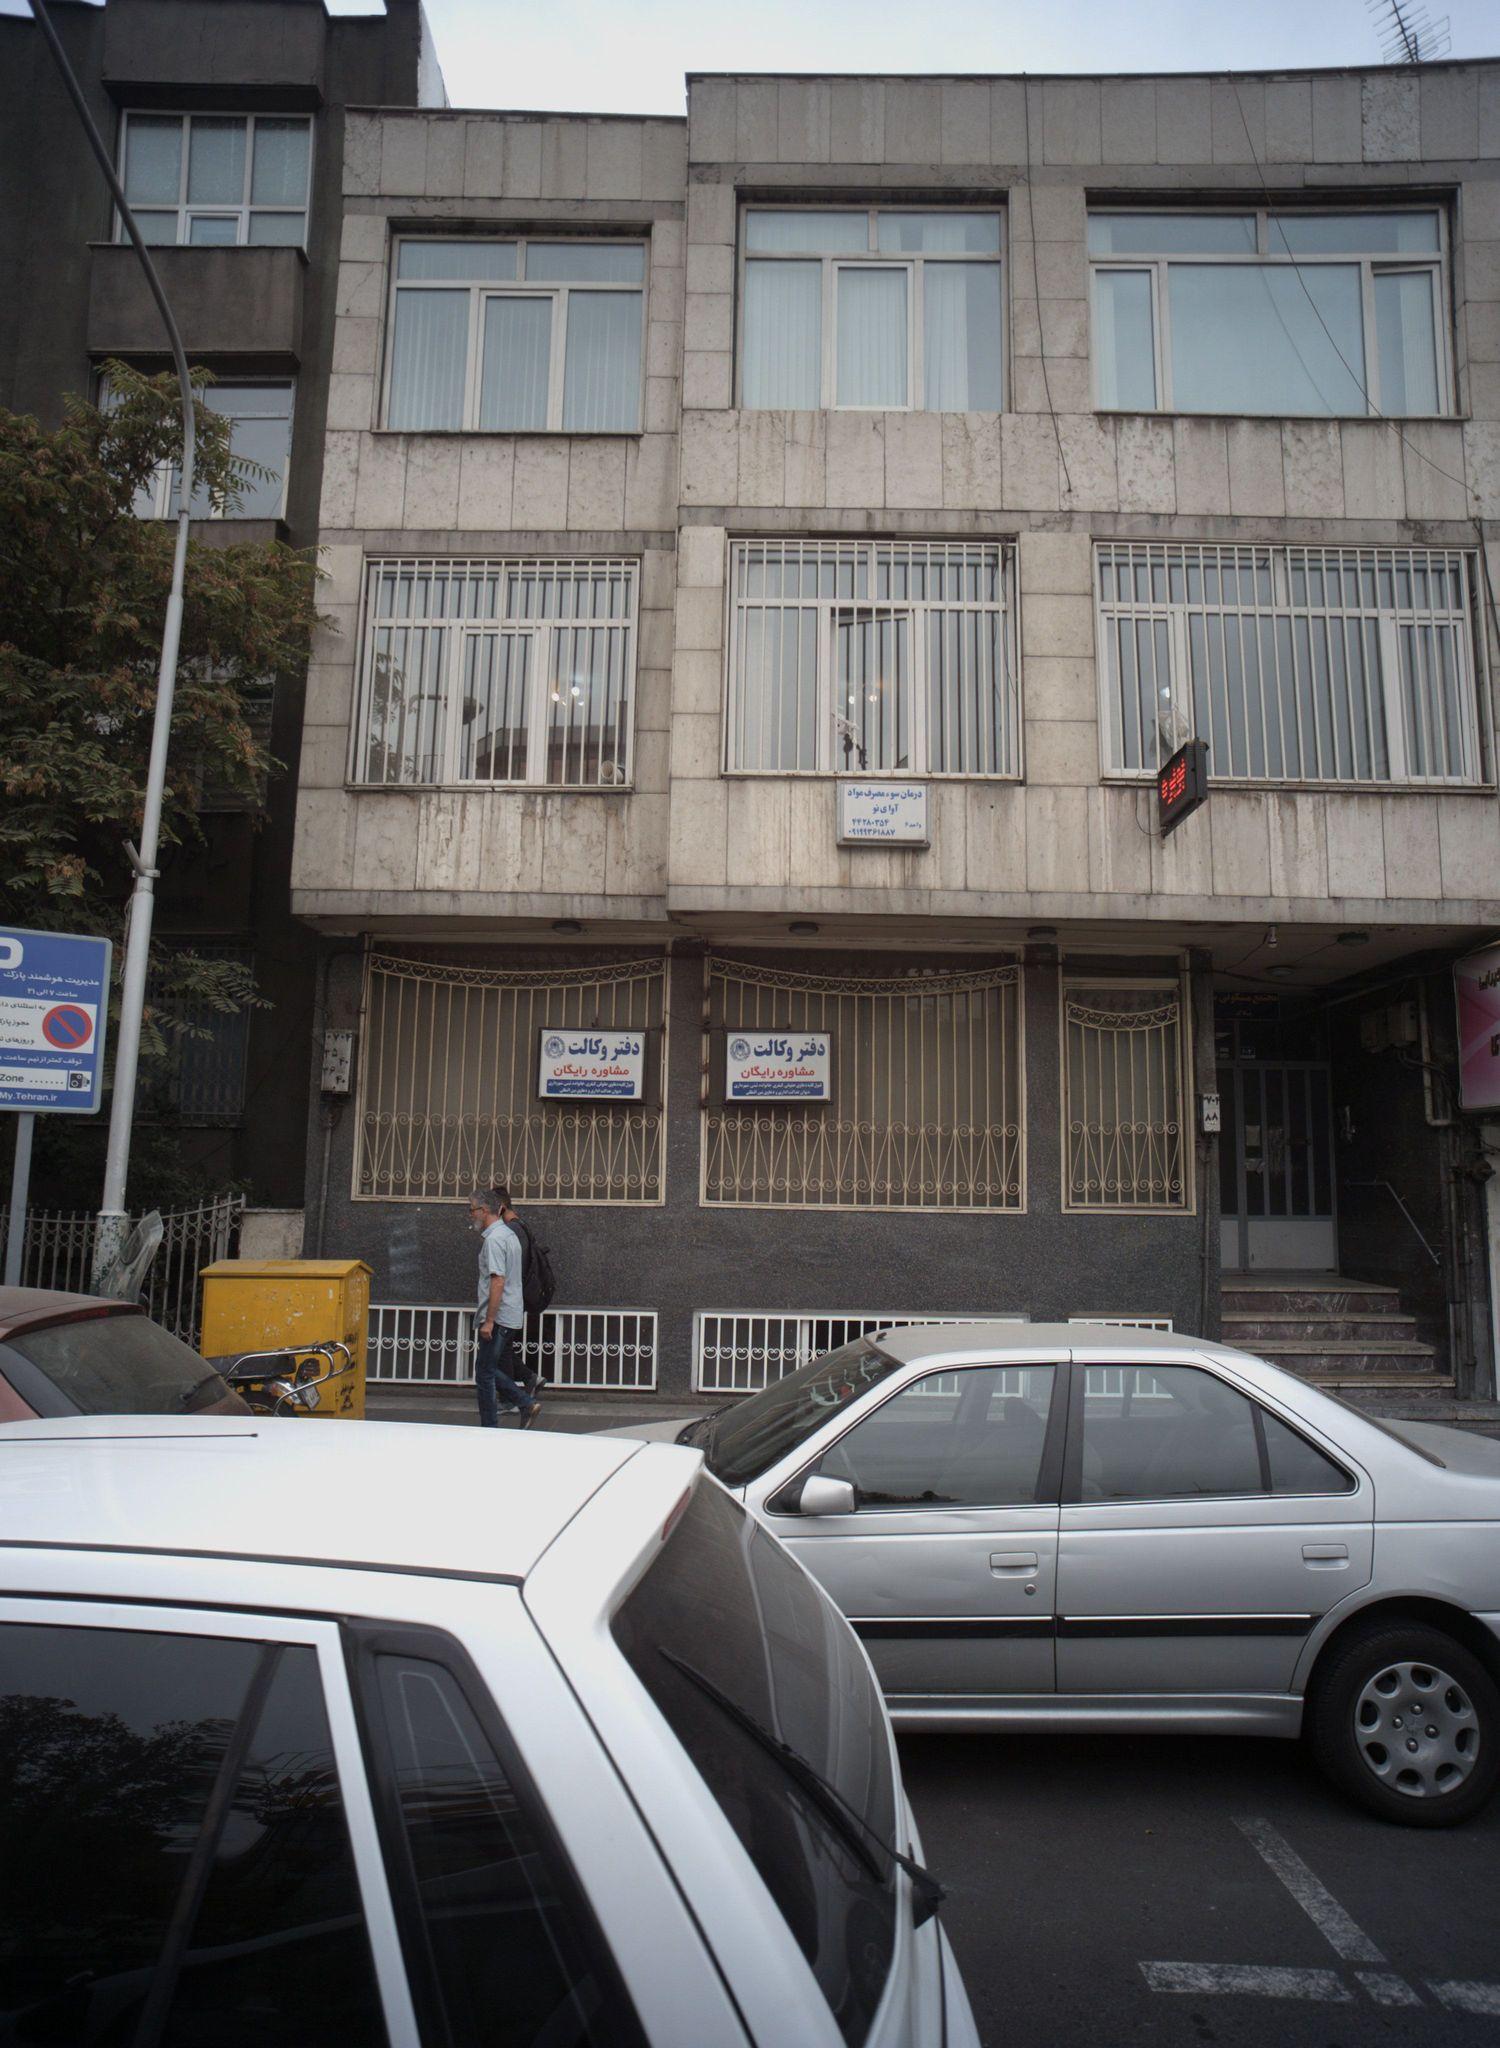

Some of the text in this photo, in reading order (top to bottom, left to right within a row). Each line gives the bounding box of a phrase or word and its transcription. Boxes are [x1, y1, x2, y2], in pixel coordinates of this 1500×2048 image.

[847, 787, 864, 799] مواد
[865, 787, 885, 800] مصرف
[900, 788, 922, 800] درمان
[27, 973, 63, 985] هوشمند
[64, 977, 100, 987] مدیریت
[36, 988, 49, 996] الی
[568, 1036, 640, 1061] دفتر وکالت
[754, 1037, 826, 1062] دفتر وکالت
[3, 1054, 27, 1062] ساعت
[62, 1058, 83, 1066] توقف
[553, 1063, 630, 1078] مشاوره رایگان
[741, 1065, 815, 1079] مشاوره رایگان
[0, 1074, 24, 1083] Zone
